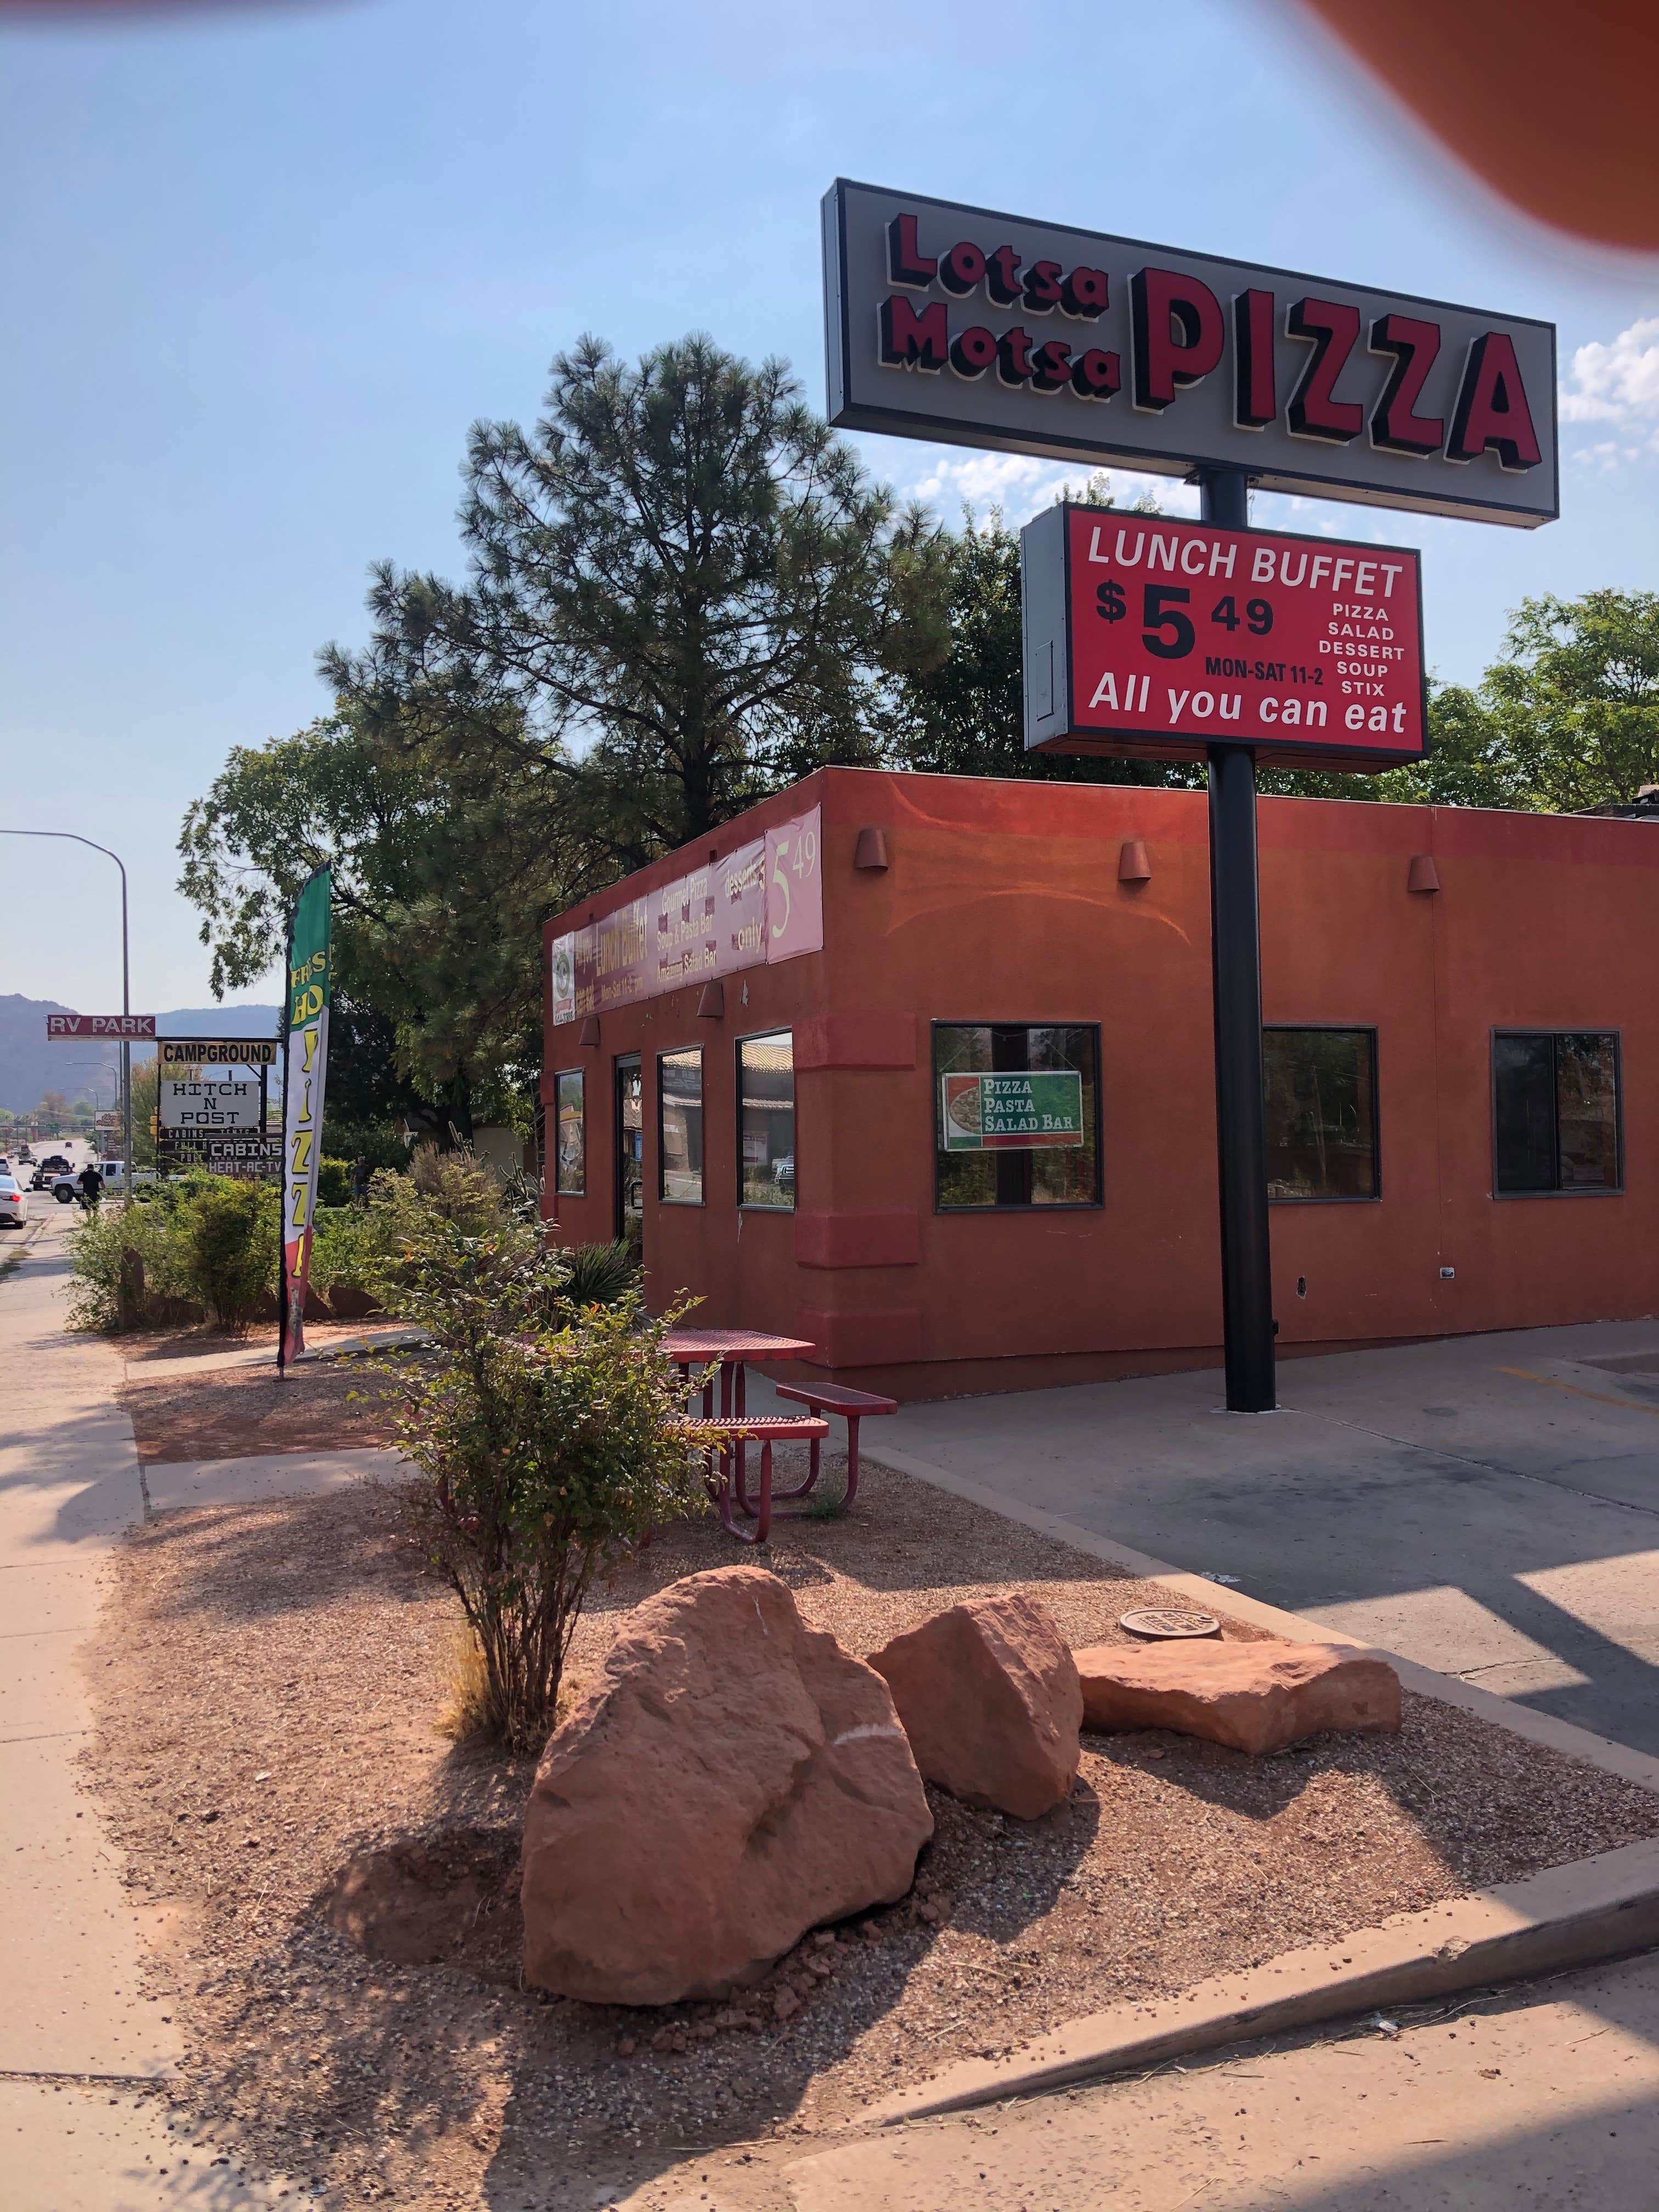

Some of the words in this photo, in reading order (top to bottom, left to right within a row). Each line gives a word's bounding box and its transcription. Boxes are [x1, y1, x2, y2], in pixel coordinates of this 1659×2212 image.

[886, 212, 1109, 321] Lotsa
[879, 295, 1121, 402] Motsa
[1130, 267, 1543, 473] PIZZA
[1088, 526, 1237, 579] LUNCH
[1251, 548, 1403, 597] BUFFET
[1333, 603, 1389, 622] PIZZA
[1328, 622, 1393, 641] SALAD
[1319, 640, 1404, 661] DESSERT
[1206, 657, 1286, 682] MON-SAT
[1291, 666, 1323, 685] 11-2
[1337, 661, 1388, 678] SOUP
[1342, 681, 1385, 697] STIX
[1088, 672, 1150, 712] All
[1168, 689, 1241, 724] you
[1260, 697, 1327, 727] can
[1345, 702, 1407, 733] eat
[772, 840, 790, 938] 5
[792, 831, 816, 879] 49
[662, 885, 689, 915] Gourmet
[690, 877, 707, 902] Pizza
[657, 930, 673, 951] Soup
[675, 927, 680, 943] &
[681, 918, 699, 943] Pasta
[701, 913, 713, 934] Bar
[738, 917, 762, 953] only
[596, 912, 620, 977] Lunch
[657, 962, 683, 983] Amazing
[684, 950, 702, 974] Salad
[704, 947, 716, 968] Bar
[50, 1017, 81, 1032] RV
[92, 1018, 152, 1033] PARK
[163, 1043, 271, 1063] CAMPGROUND
[173, 1084, 247, 1096] HITCH
[984, 1079, 1032, 1094] PIZZA
[204, 1098, 217, 1110] N
[984, 1098, 1035, 1113] PASTA
[180, 1112, 240, 1124] POST
[985, 1116, 1038, 1132] SALAD
[1042, 1114, 1073, 1130] BAR
[168, 1130, 204, 1138] CABINS
[211, 1143, 282, 1156] CABINS
[208, 1161, 281, 1173] HEAT-AC-TV
